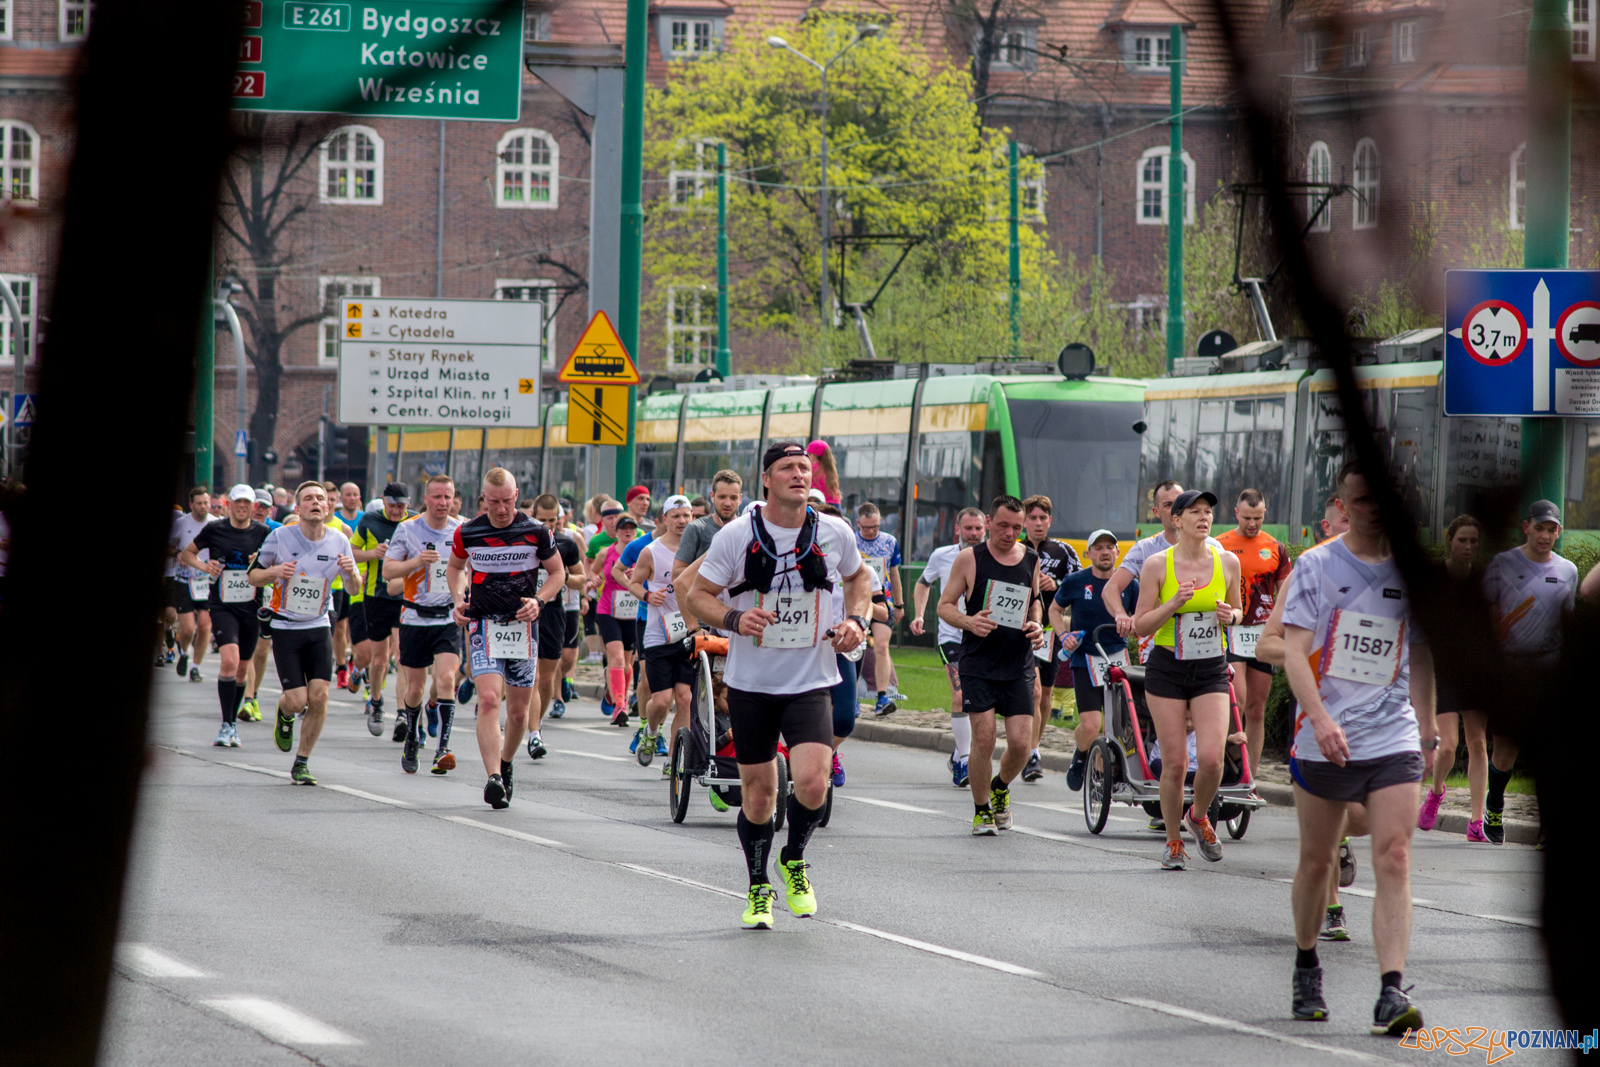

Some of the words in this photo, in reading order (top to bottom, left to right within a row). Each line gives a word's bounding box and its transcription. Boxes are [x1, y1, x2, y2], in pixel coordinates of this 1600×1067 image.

[293, 7, 304, 25] E
[308, 8, 341, 27] 261
[363, 8, 501, 39] Bydgoszcz
[361, 43, 489, 70] Katowice
[359, 77, 480, 105] Września
[389, 306, 448, 319] Katedra
[388, 324, 455, 341] Cytadela
[388, 349, 425, 365] Stary
[431, 349, 474, 365] Rynek
[387, 367, 429, 383] Urząd
[439, 368, 490, 381] Miasta
[387, 385, 438, 401] Szpital
[444, 387, 476, 400] Klin.
[482, 391, 496, 400] nr
[503, 388, 510, 400] 1
[387, 404, 433, 417] Centr.
[438, 405, 511, 422] Onkologii
[471, 552, 531, 561] BRIDGESTONE
[228, 580, 251, 589] 2462
[292, 586, 321, 600] 9930
[620, 600, 639, 608] 6769
[996, 595, 1025, 611] 2797
[774, 610, 809, 625] 3491
[495, 631, 522, 642] 9417
[1189, 626, 1218, 640] 4261
[1343, 633, 1394, 657] 11587
